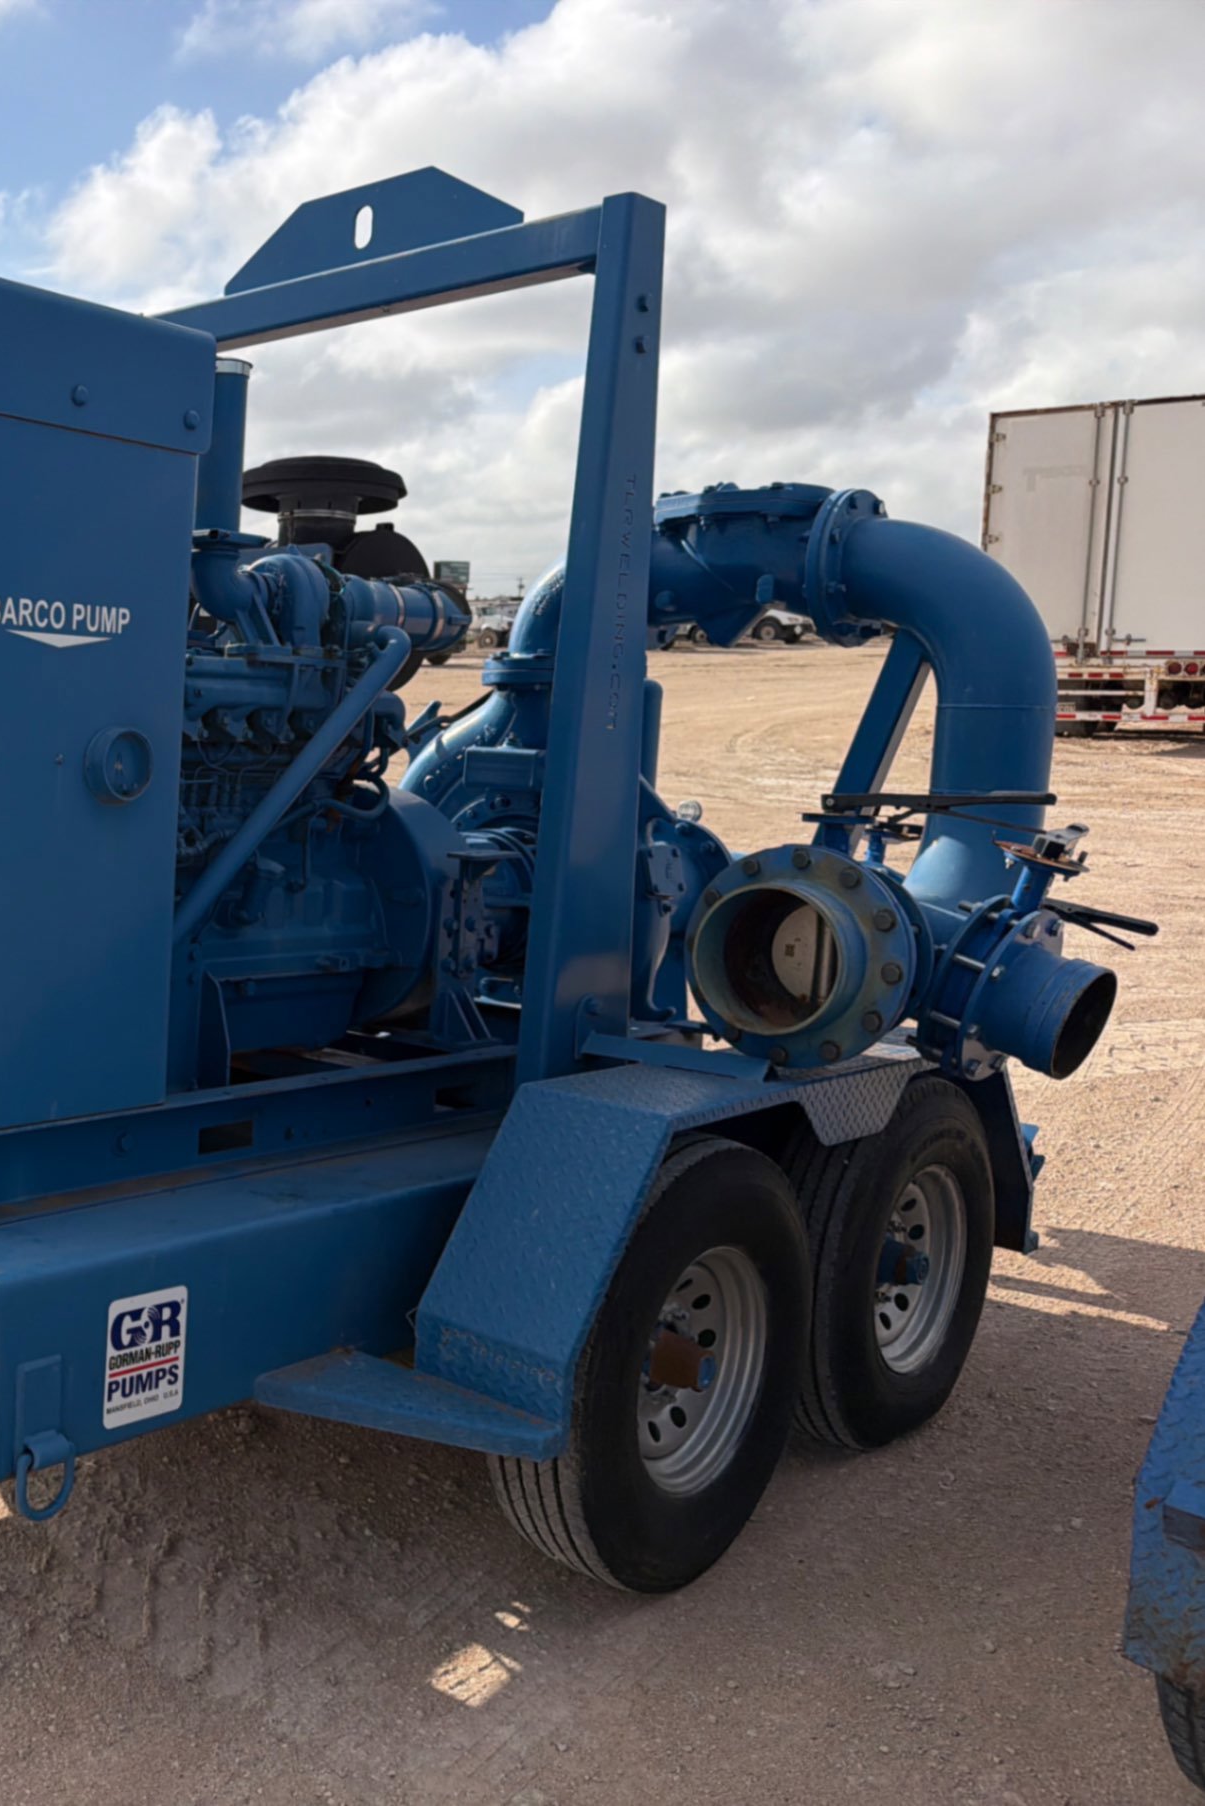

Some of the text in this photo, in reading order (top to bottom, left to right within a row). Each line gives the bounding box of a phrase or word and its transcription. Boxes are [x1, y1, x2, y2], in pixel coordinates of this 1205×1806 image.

[72, 602, 131, 635] PUMP
[108, 1339, 181, 1371] GORMAN-RUPP
[107, 1363, 180, 1403] PUMPS
